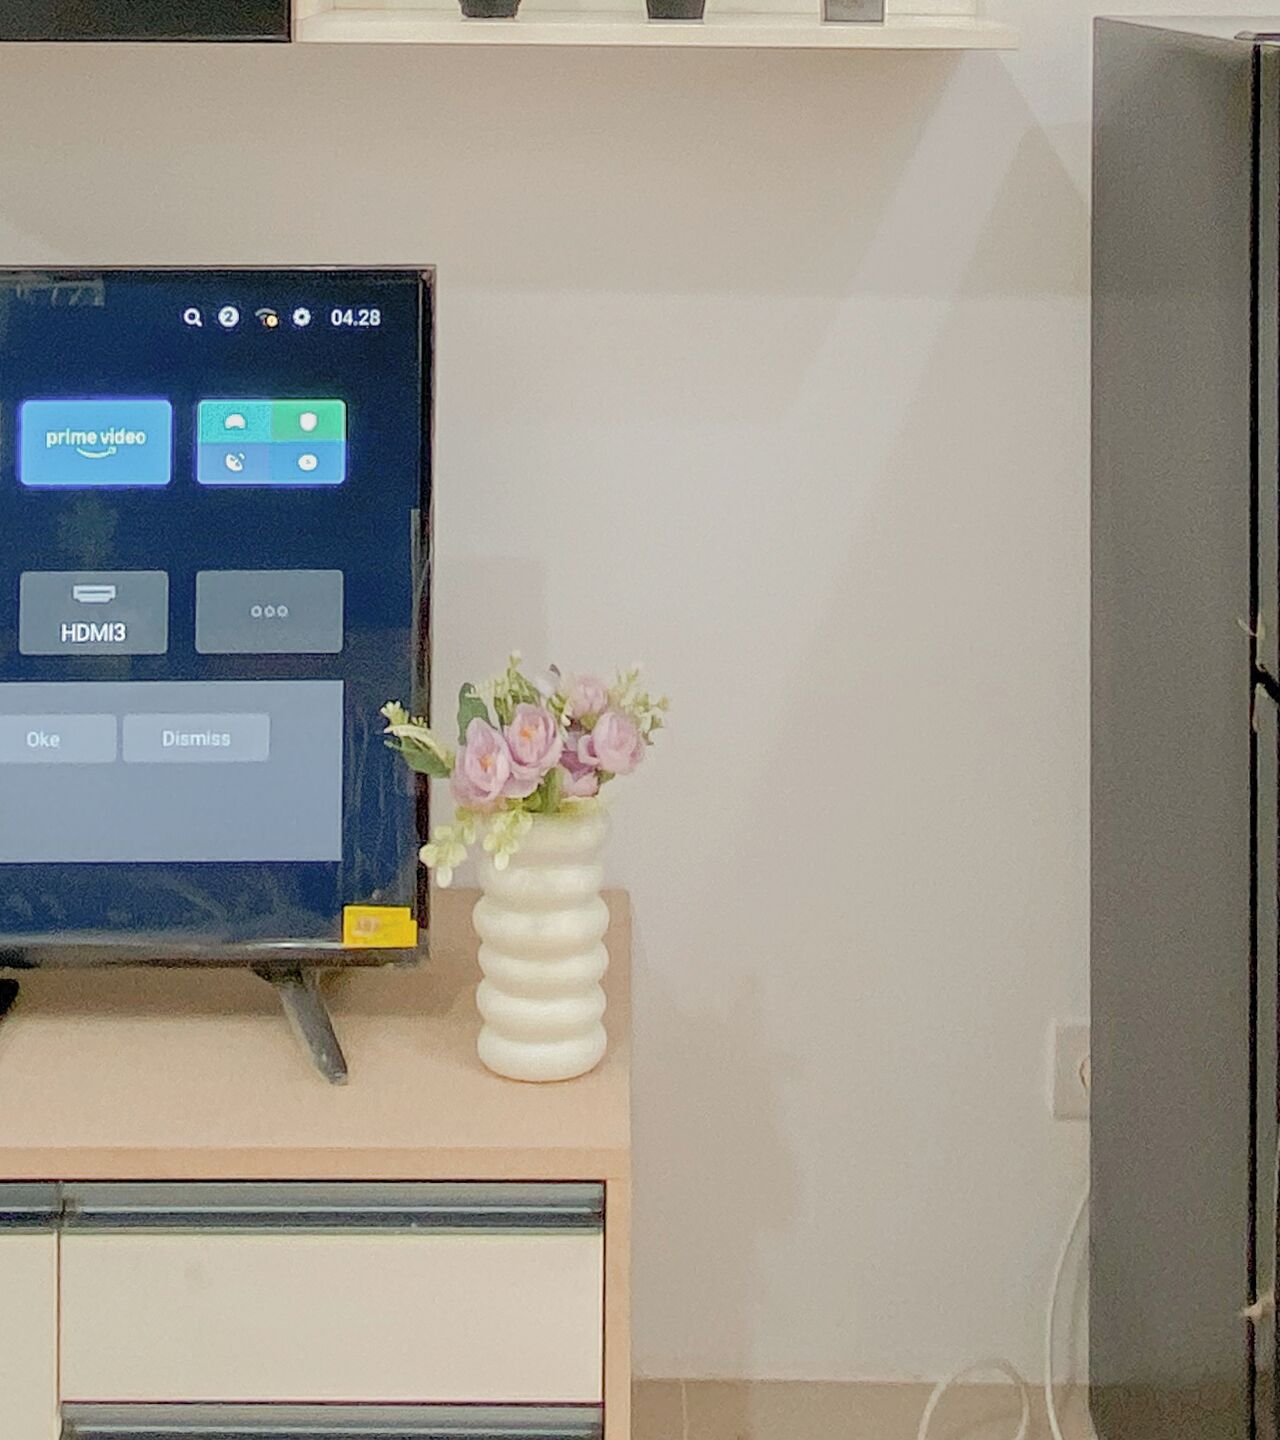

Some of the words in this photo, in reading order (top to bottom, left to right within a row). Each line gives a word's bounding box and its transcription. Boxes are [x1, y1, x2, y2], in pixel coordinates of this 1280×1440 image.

[331, 308, 381, 326] 04.28
[46, 428, 97, 447] prime
[101, 428, 146, 447] video
[61, 624, 126, 642] HDMI3
[27, 731, 60, 748] Oke
[162, 729, 231, 748] Dismiss
